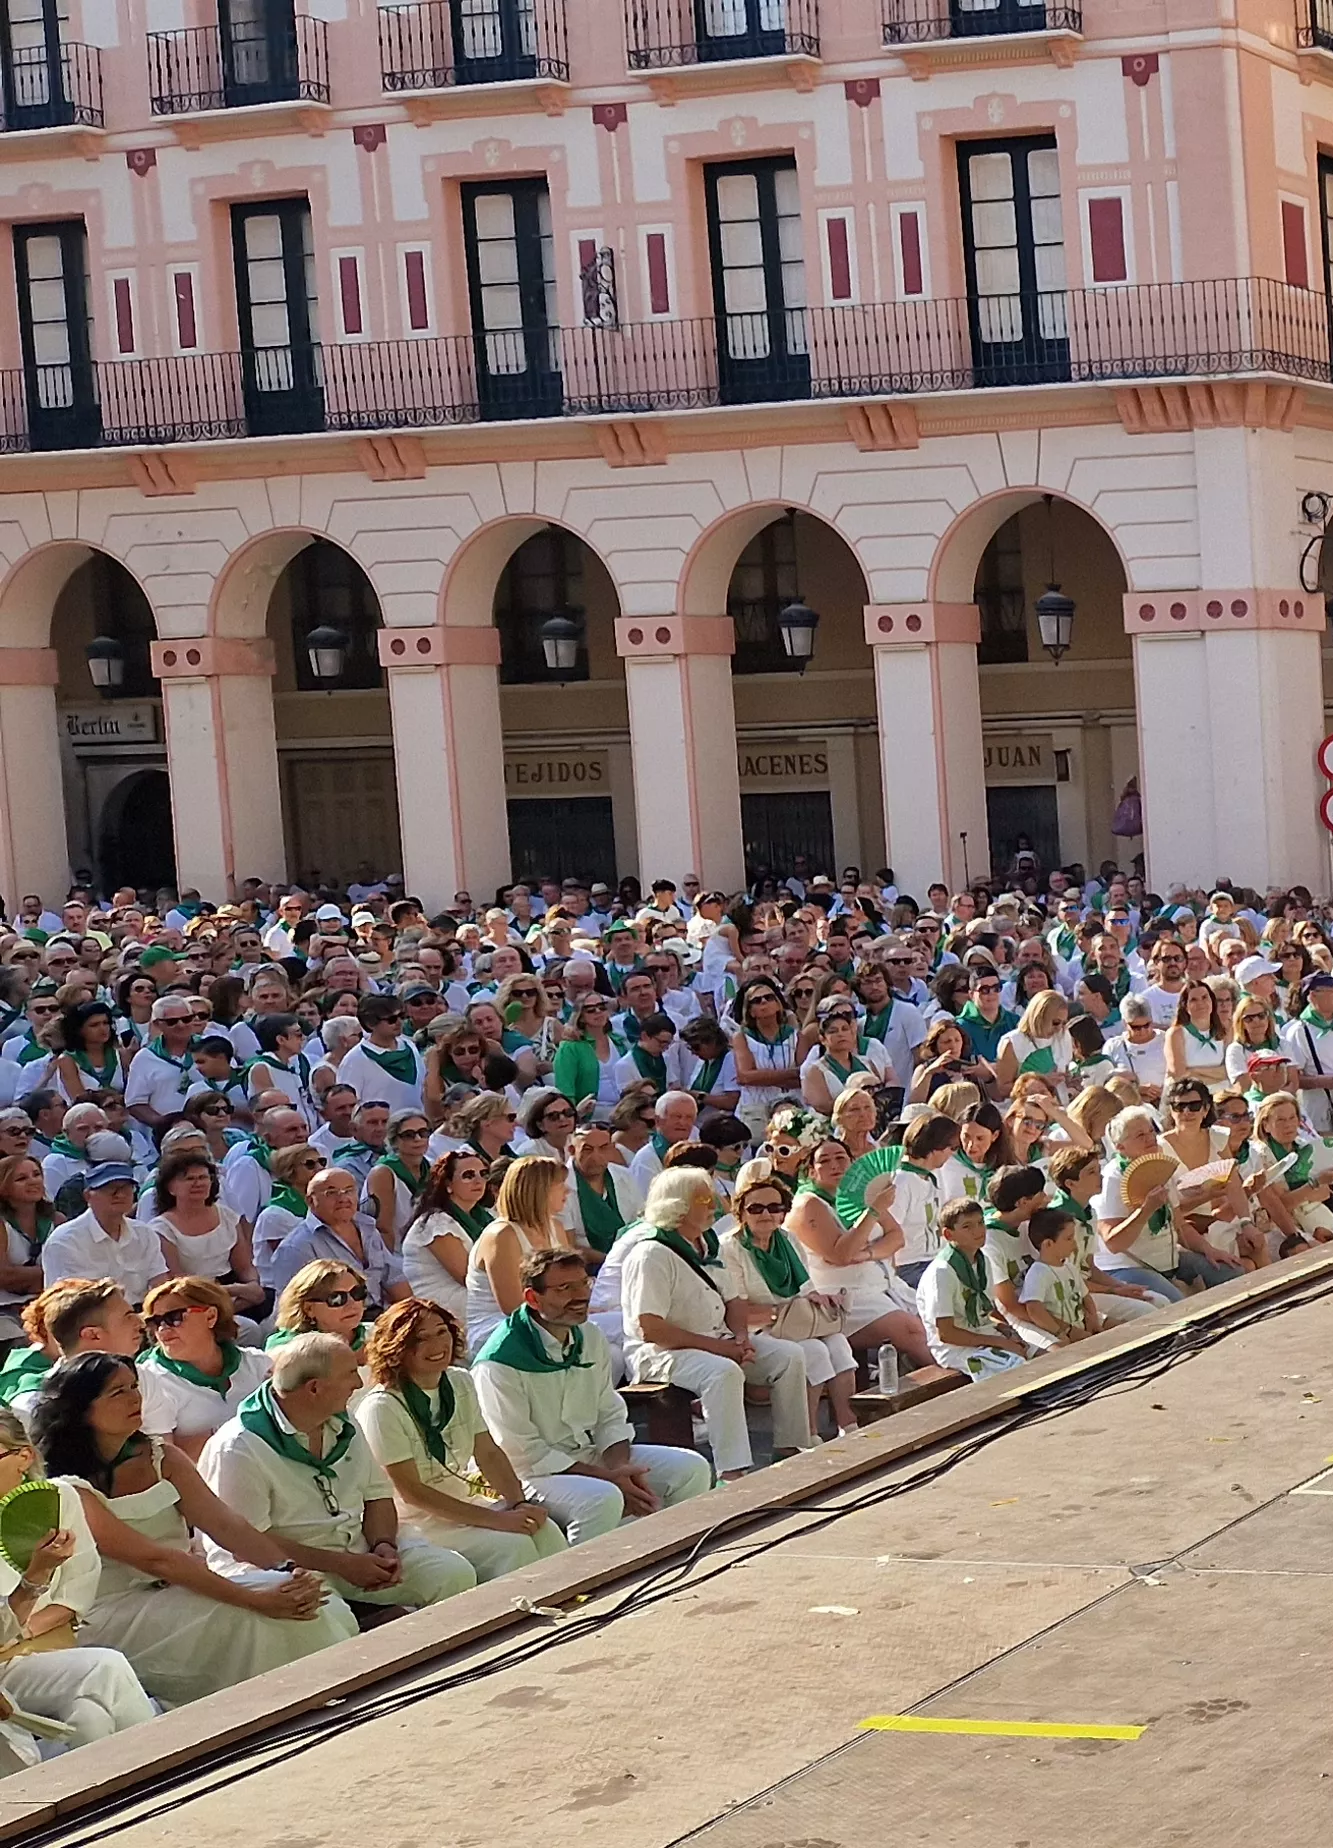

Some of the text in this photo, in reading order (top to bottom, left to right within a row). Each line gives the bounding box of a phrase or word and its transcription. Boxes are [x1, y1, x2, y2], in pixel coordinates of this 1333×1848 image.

[738, 754, 828, 777] ACENES
[984, 745, 1041, 768] JUAN
[504, 762, 603, 785] TEJIDOS
